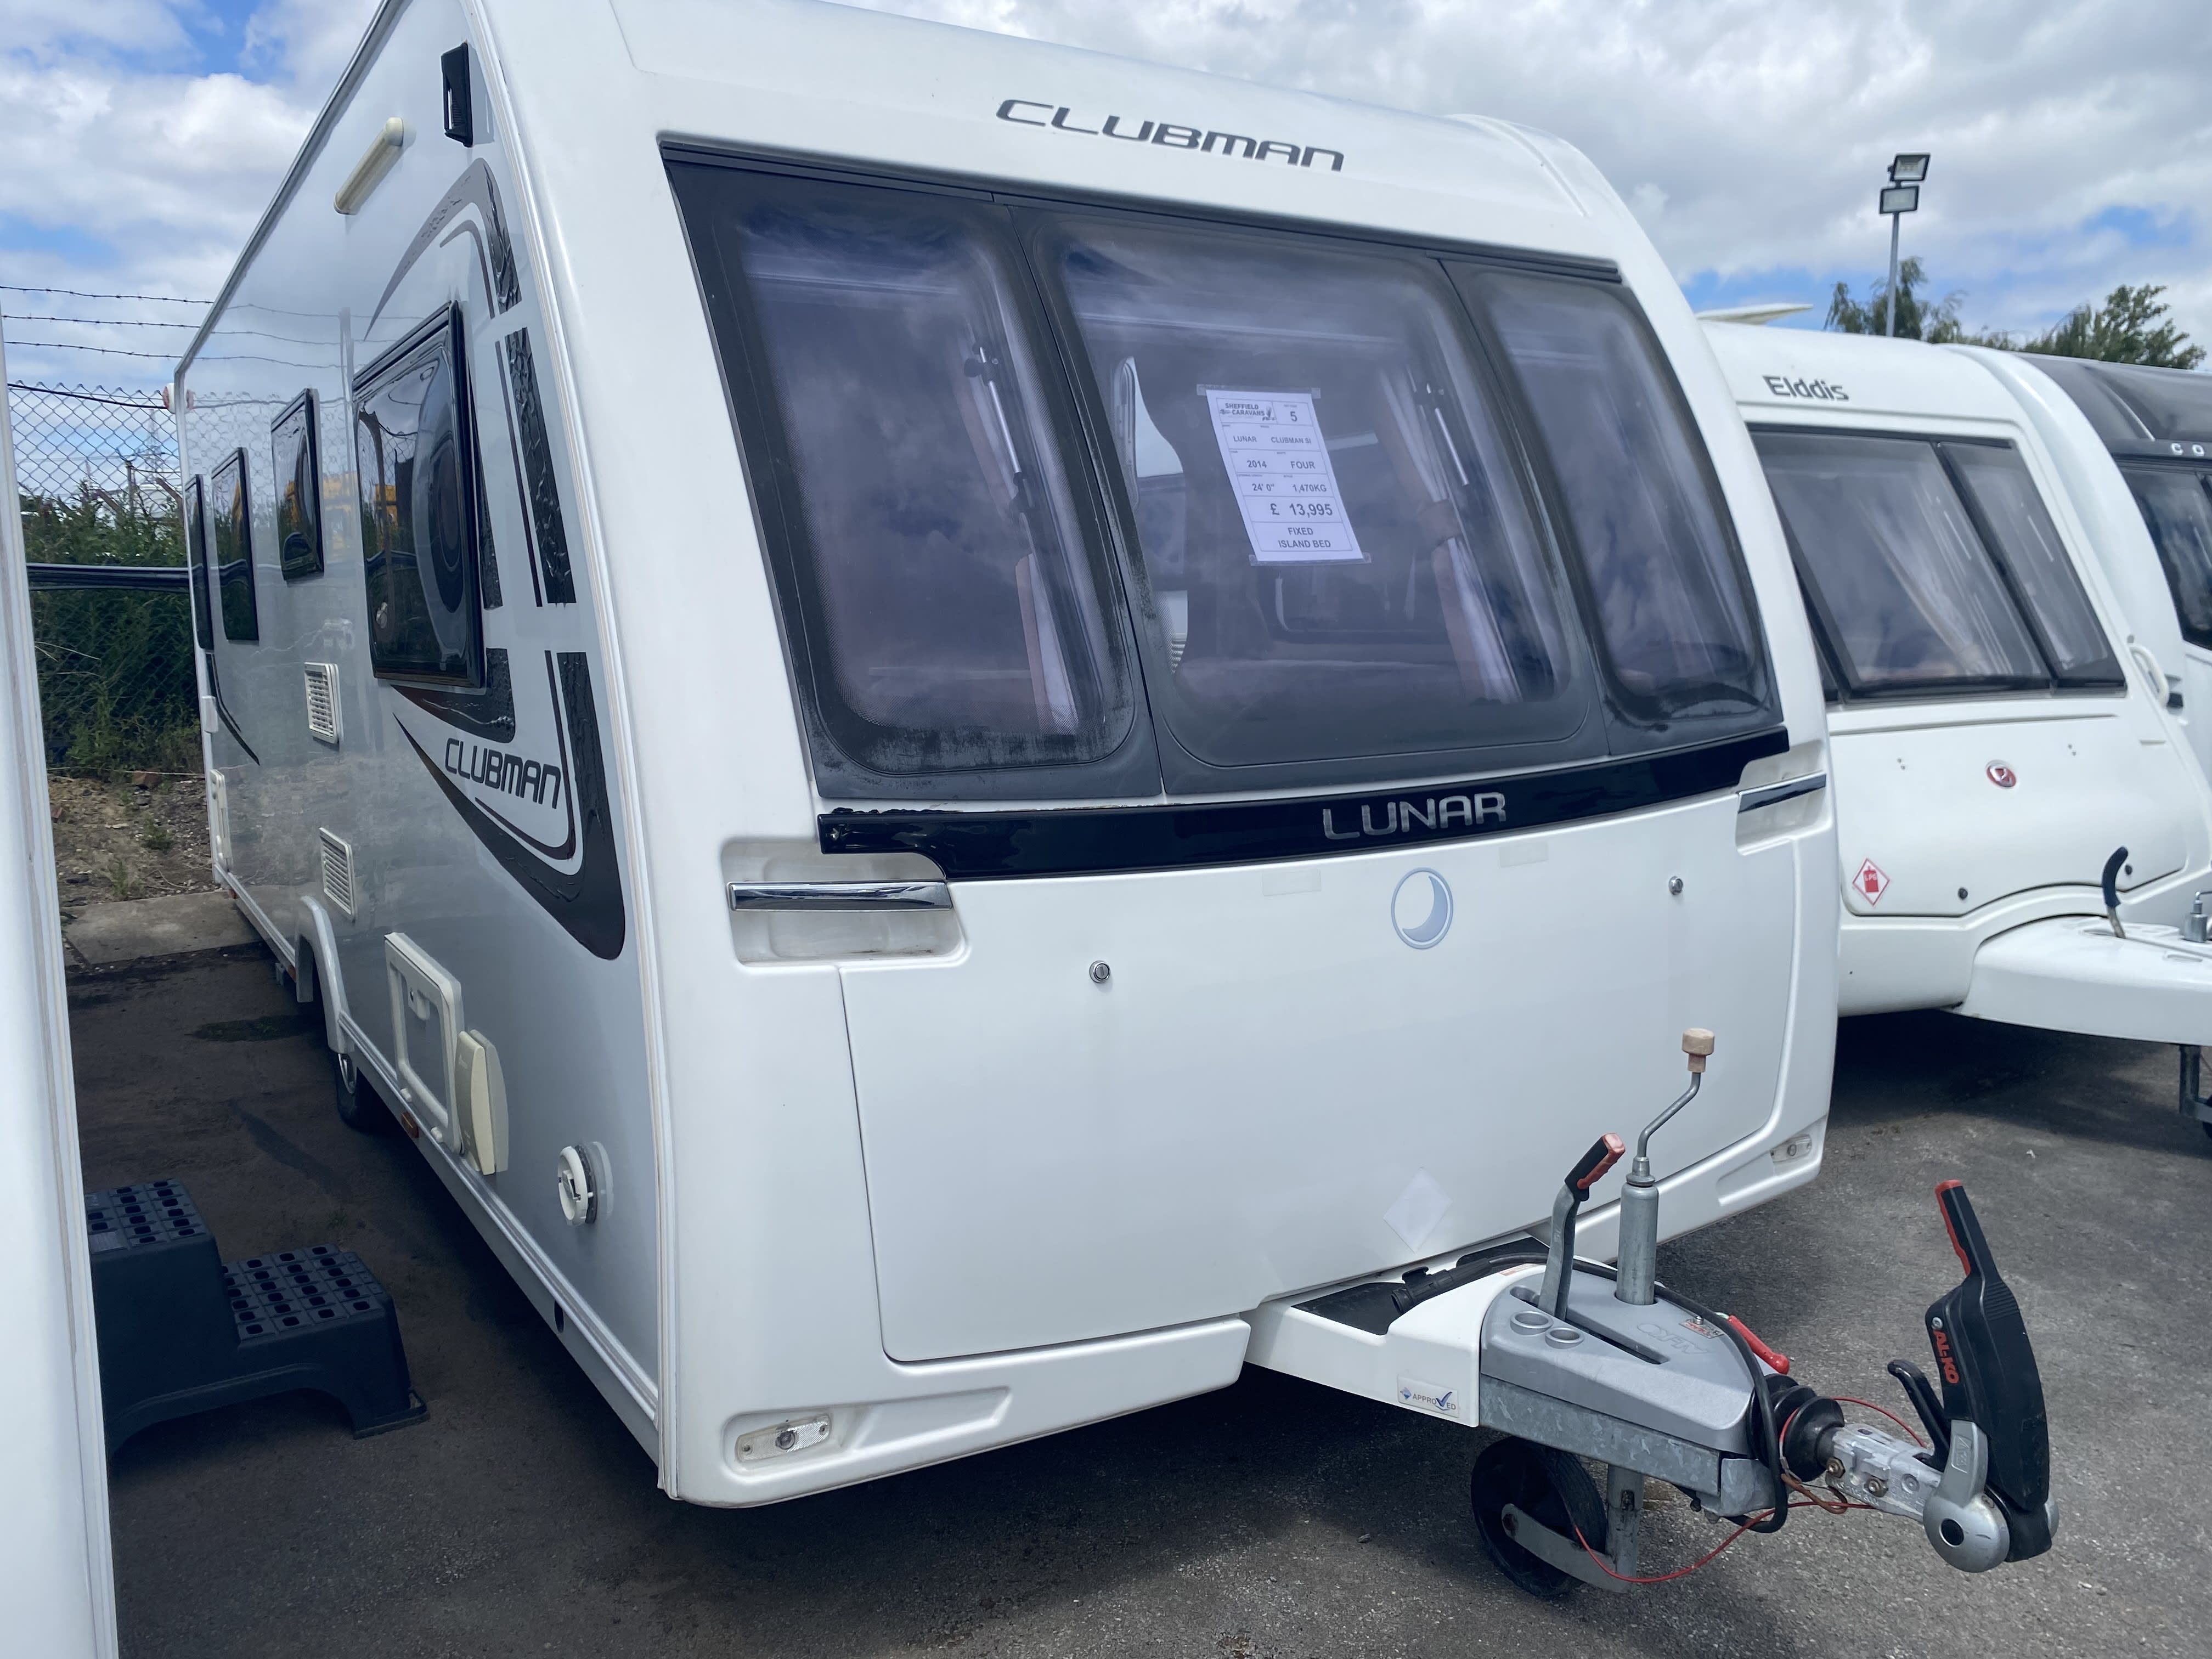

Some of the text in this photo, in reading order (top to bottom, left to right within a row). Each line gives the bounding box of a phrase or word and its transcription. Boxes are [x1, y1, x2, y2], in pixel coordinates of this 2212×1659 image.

[995, 99, 1344, 172] CLUBMAN
[1762, 375, 1849, 400] Elddis
[1290, 411, 1297, 422] 5
[1247, 460, 1267, 468] 2014
[1290, 461, 1315, 469] FOUR
[1293, 484, 1327, 493] 1,470KG
[1270, 503, 1333, 518] £ 13,995
[445, 738, 561, 809] CLUBMAN
[1323, 792, 1506, 840] LUNAR
[1933, 1329, 1959, 1384] AL-KO
